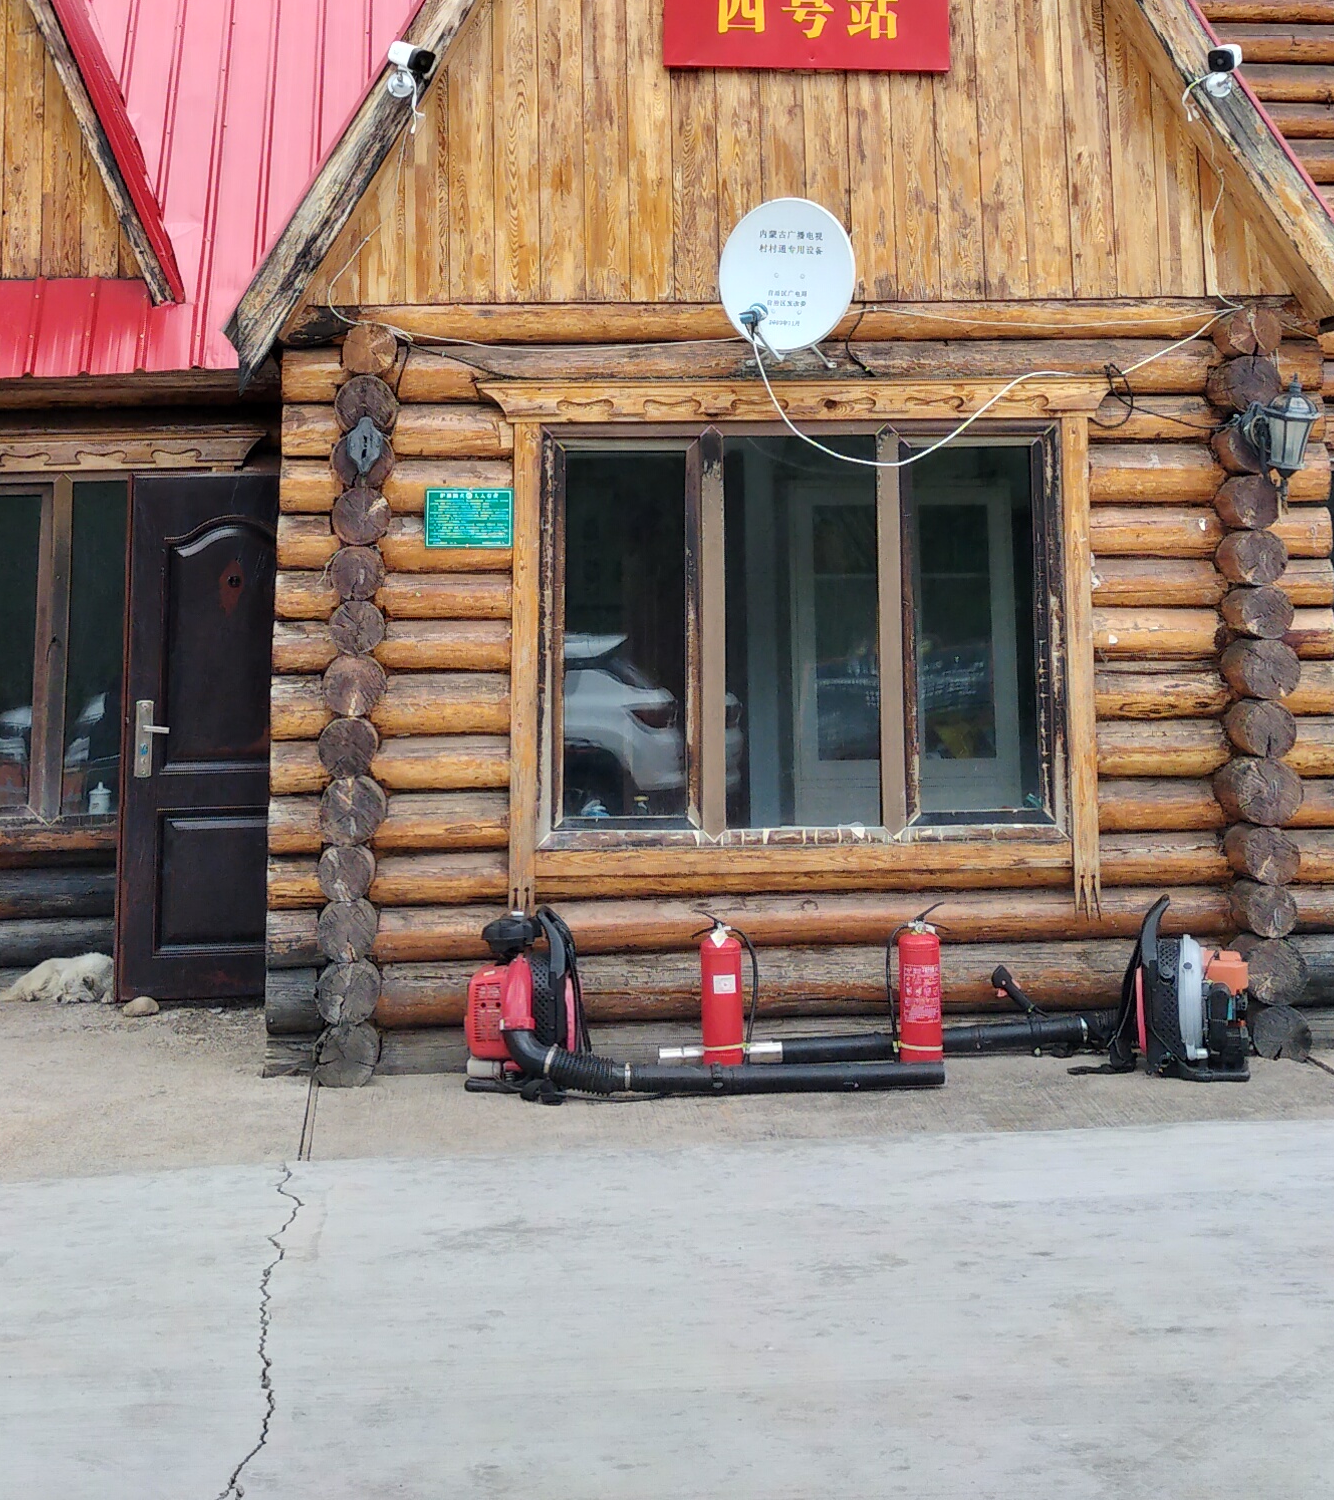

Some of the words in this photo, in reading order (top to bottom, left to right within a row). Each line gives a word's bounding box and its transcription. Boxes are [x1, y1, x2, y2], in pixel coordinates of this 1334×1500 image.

[759, 229, 823, 241] 内蒙古广播电视
[759, 244, 823, 255] 村村通专用设备
